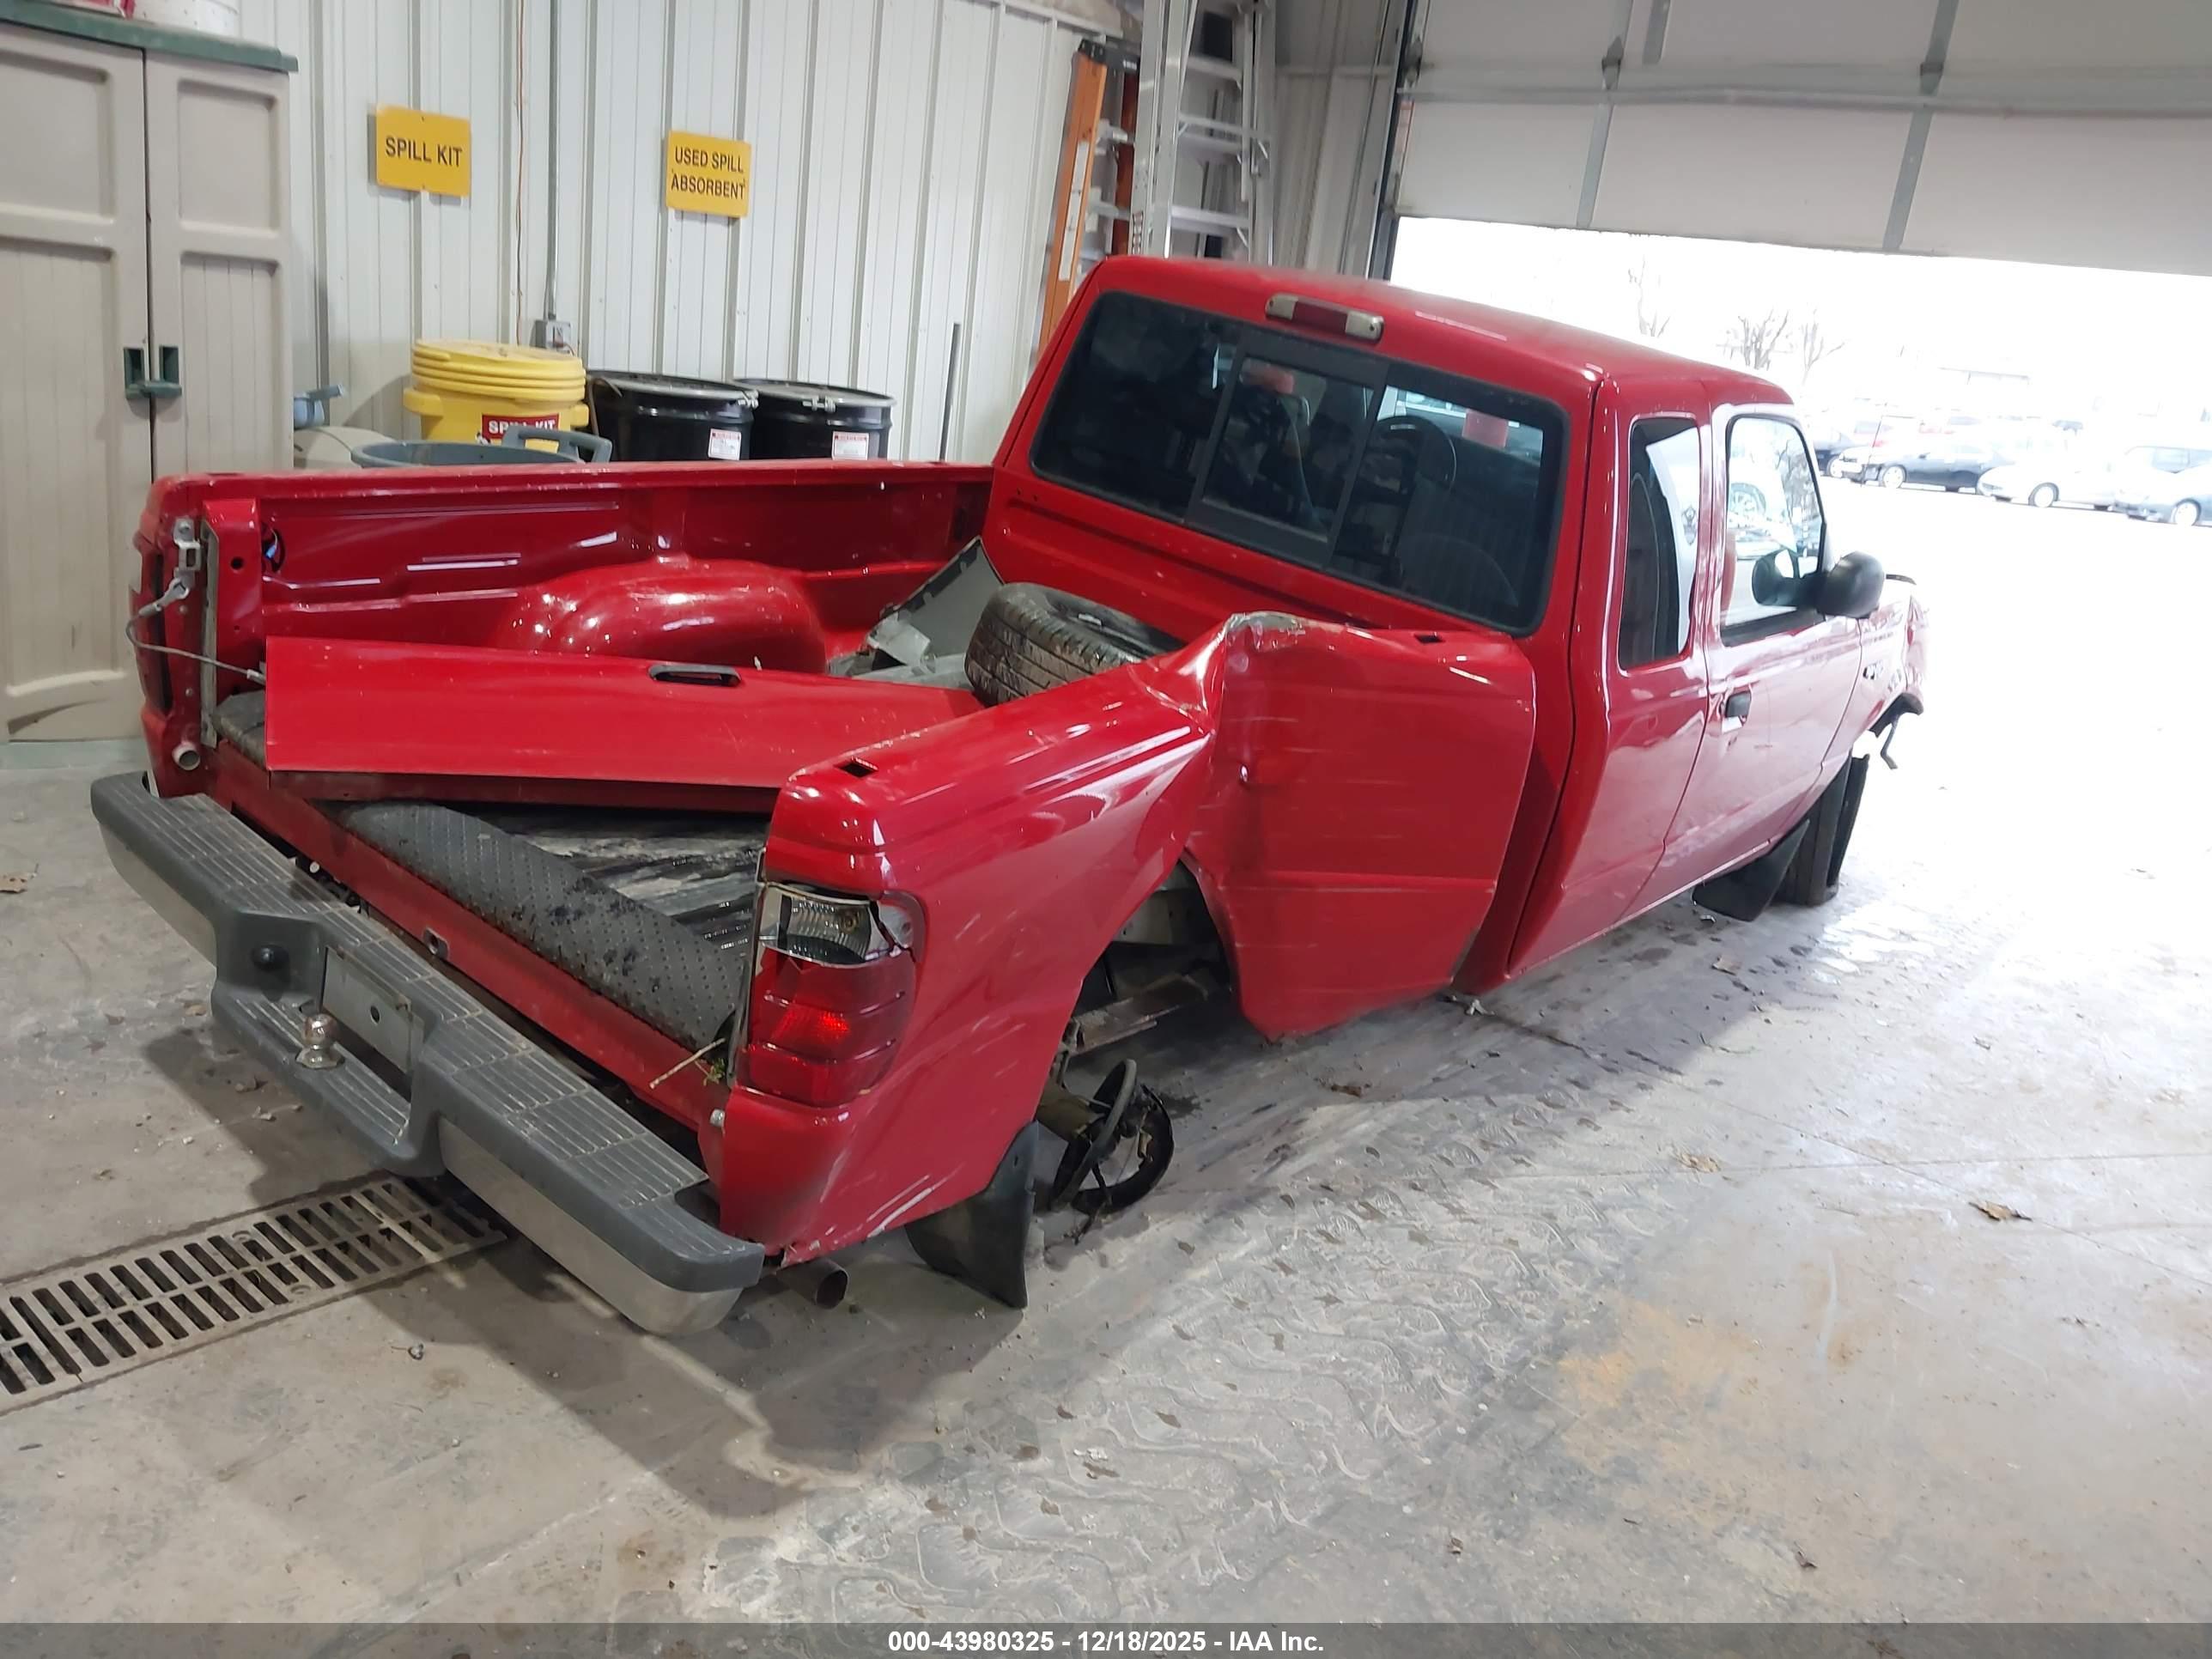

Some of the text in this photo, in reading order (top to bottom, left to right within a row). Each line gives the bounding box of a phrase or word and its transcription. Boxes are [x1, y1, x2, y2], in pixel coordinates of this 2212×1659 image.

[386, 136, 463, 167] SPILL KIT
[675, 146, 744, 173] USED SPILL
[672, 173, 745, 199] ABSORBENT
